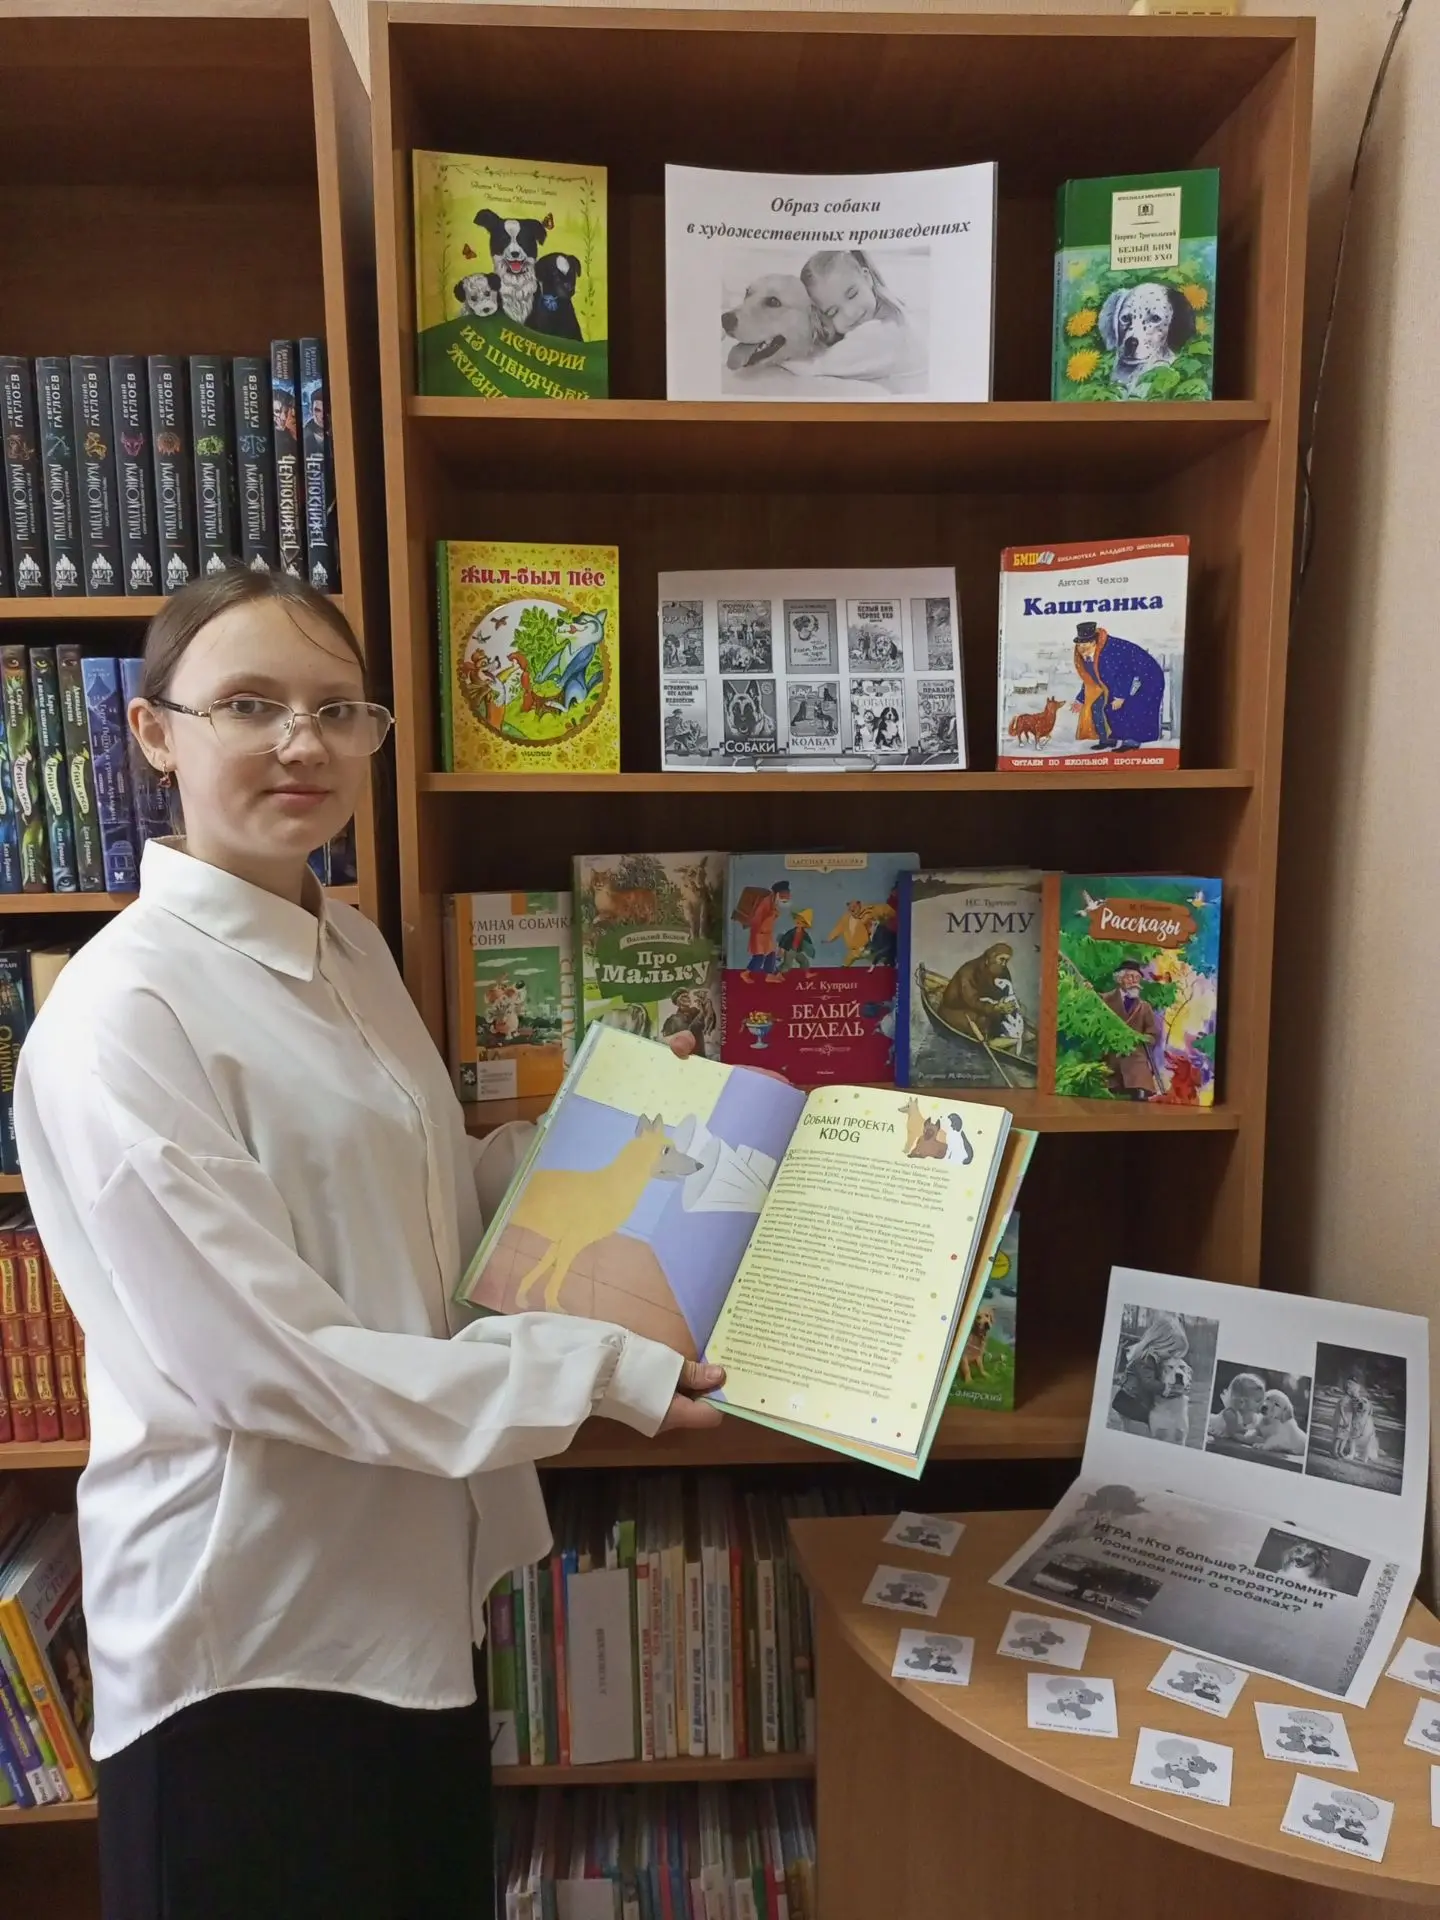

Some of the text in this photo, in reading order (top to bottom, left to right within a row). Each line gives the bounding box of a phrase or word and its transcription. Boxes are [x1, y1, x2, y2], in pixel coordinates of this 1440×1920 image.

[771, 197, 881, 216] Образ собаки
[687, 220, 971, 244] в художественных произведениях
[1118, 243, 1172, 254] БЕЛЫЙ БИМ
[1154, 253, 1172, 261] УХО
[460, 325, 485, 351] ИЗ
[500, 328, 586, 371] ИСТОРИИ
[447, 343, 508, 399] ЖИЗН
[12, 374, 24, 428] ГАГЛОЕВ
[52, 375, 63, 428] ГАГЛОЕВ
[88, 373, 100, 426] ГАГЛОЕВ
[127, 373, 139, 426] ГАГЛОЕВ
[163, 373, 175, 426] ГАГЛОЕВ
[205, 373, 216, 427] ГАГЛОЕВ
[248, 375, 259, 428] ГАГЛОЕВ
[10, 464, 29, 540] ПАНДЕМОНИУМ
[48, 464, 66, 540] ПАНДЕМОНИУМ
[85, 462, 103, 538] ПАНДЕМОНИУМ
[124, 462, 142, 539] ПАНДЕМОНИУМ
[160, 463, 178, 539] ПАНДЕМОНИУМ
[202, 463, 217, 539] ПАНДЕМОНИУМ
[244, 464, 261, 540] ПАНДЕМОНИУМ
[1057, 553, 1097, 562] БИБЛИОТЕКА
[1136, 542, 1175, 551] ШКОЛЬНИКА
[19, 569, 41, 581] МИР
[56, 569, 77, 581] МИР
[92, 569, 114, 581] МИР
[131, 569, 153, 581] МИР
[167, 569, 189, 581] МИР
[1057, 576, 1129, 587] Антон Чехов
[1023, 595, 1164, 616] Каштанка
[725, 740, 775, 753] СОБАКИ
[791, 738, 837, 746] КОЛБАТ
[1064, 758, 1108, 766] ШКОЛЬНОЙ
[469, 919, 514, 931] УМНАЯ
[946, 912, 1035, 933] МУМУ
[1101, 907, 1180, 942] Рассказы
[469, 934, 506, 946] СОНЯ
[637, 951, 677, 969] Про
[600, 960, 710, 985] Мальку
[820, 981, 858, 993] Куприн
[792, 1000, 860, 1019] БЕЛЫЙ
[788, 1021, 865, 1040] ПУДЕЛЬ
[803, 1114, 895, 1133] СОБАКИ ПРОЕКТА
[819, 1127, 860, 1143] KDOG
[1094, 1521, 1132, 1540] ИГРА
[1137, 1536, 1171, 1552] «Кто
[1170, 1570, 1205, 1584] книг
[1224, 1586, 1301, 1613] собаках?
[1207, 1570, 1323, 1609] литературы и
